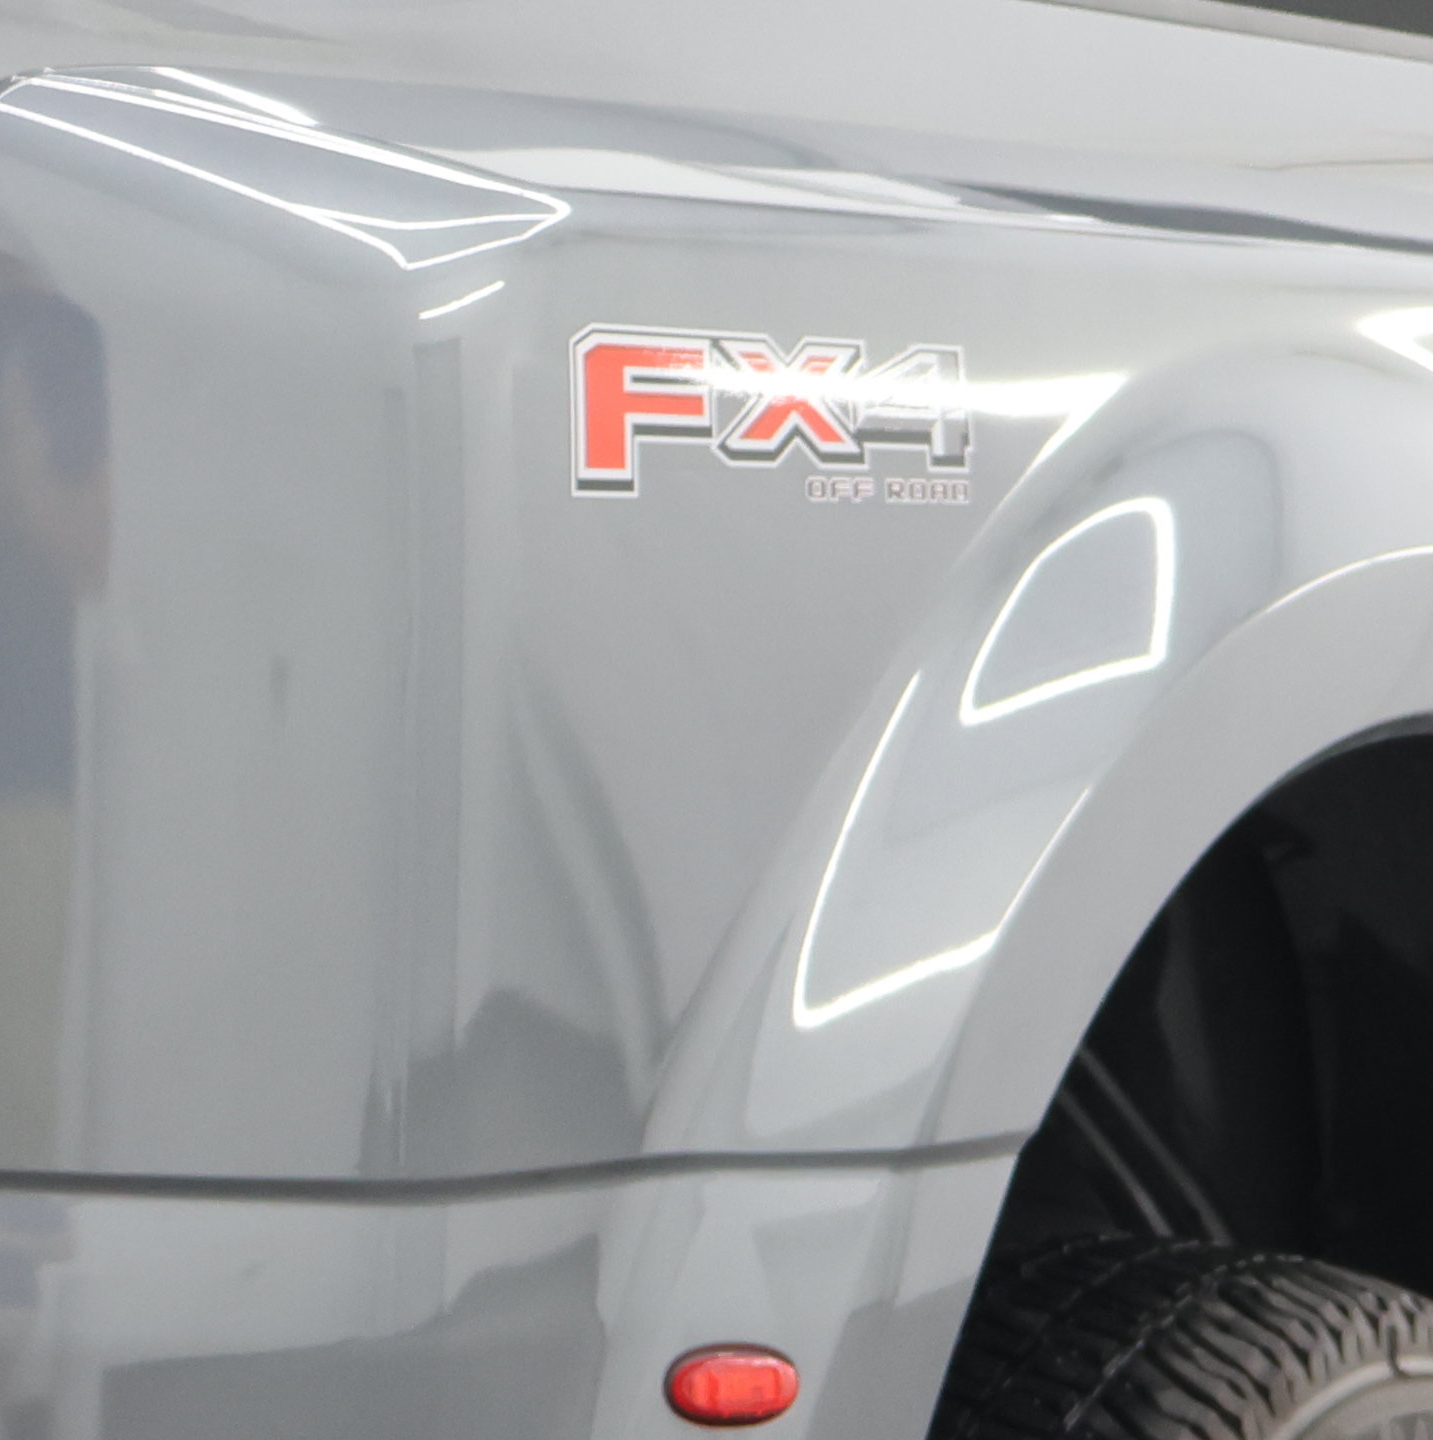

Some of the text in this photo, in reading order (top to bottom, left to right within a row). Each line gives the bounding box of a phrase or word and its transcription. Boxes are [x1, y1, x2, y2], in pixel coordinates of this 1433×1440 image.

[569, 323, 970, 497] FX4
[805, 475, 971, 505] OFF ROAD
